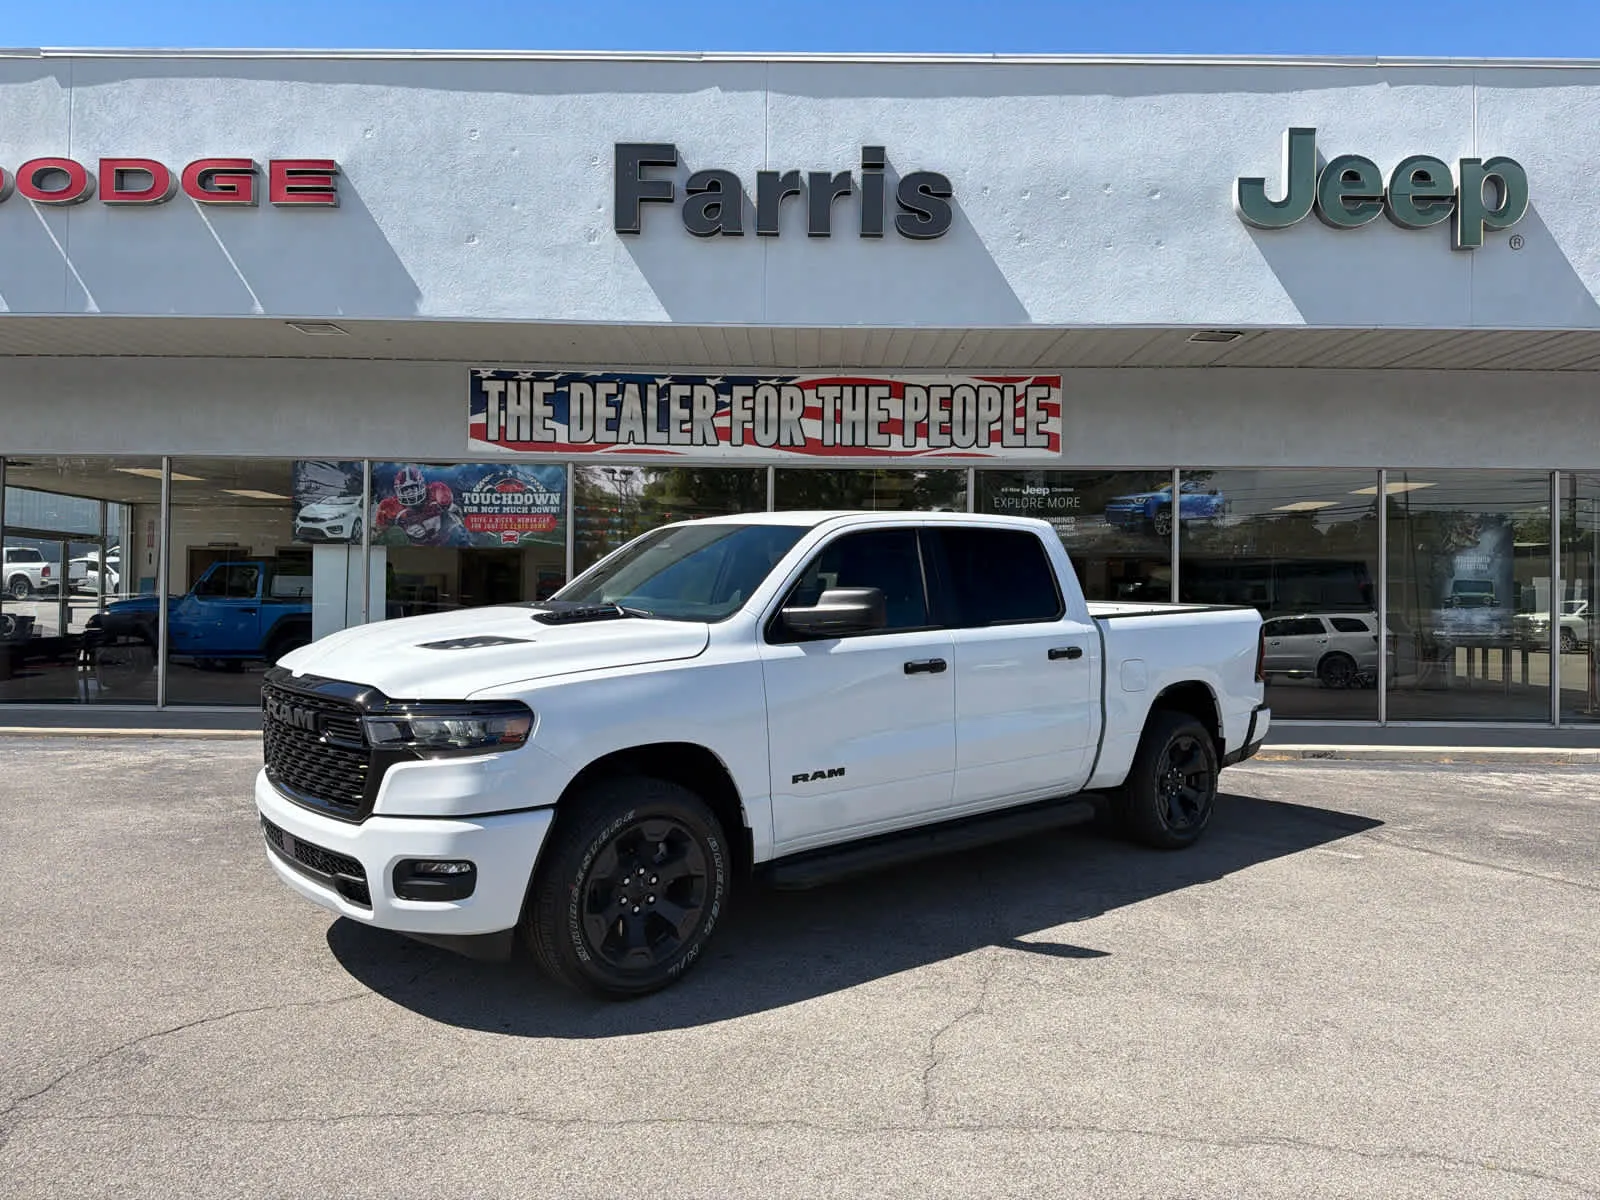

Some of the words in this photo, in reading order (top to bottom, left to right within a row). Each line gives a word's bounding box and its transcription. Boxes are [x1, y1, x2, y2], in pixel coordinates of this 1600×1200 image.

[0, 156, 336, 205] ODGE
[614, 142, 953, 240] Farris
[1233, 127, 1529, 249] Jeep
[480, 379, 557, 443] THE
[568, 381, 720, 447] DEALER
[730, 383, 806, 448] FOR
[816, 384, 892, 448] THE
[902, 384, 1051, 449] PEOPLE
[462, 492, 561, 505] TOUCHDOWN
[1022, 484, 1050, 496] Jeep
[502, 506, 528, 514] MUCH
[993, 497, 1045, 509] EXPLORE
[1047, 497, 1080, 508] MORE
[266, 699, 317, 732] RAM
[792, 767, 846, 785] RAM
